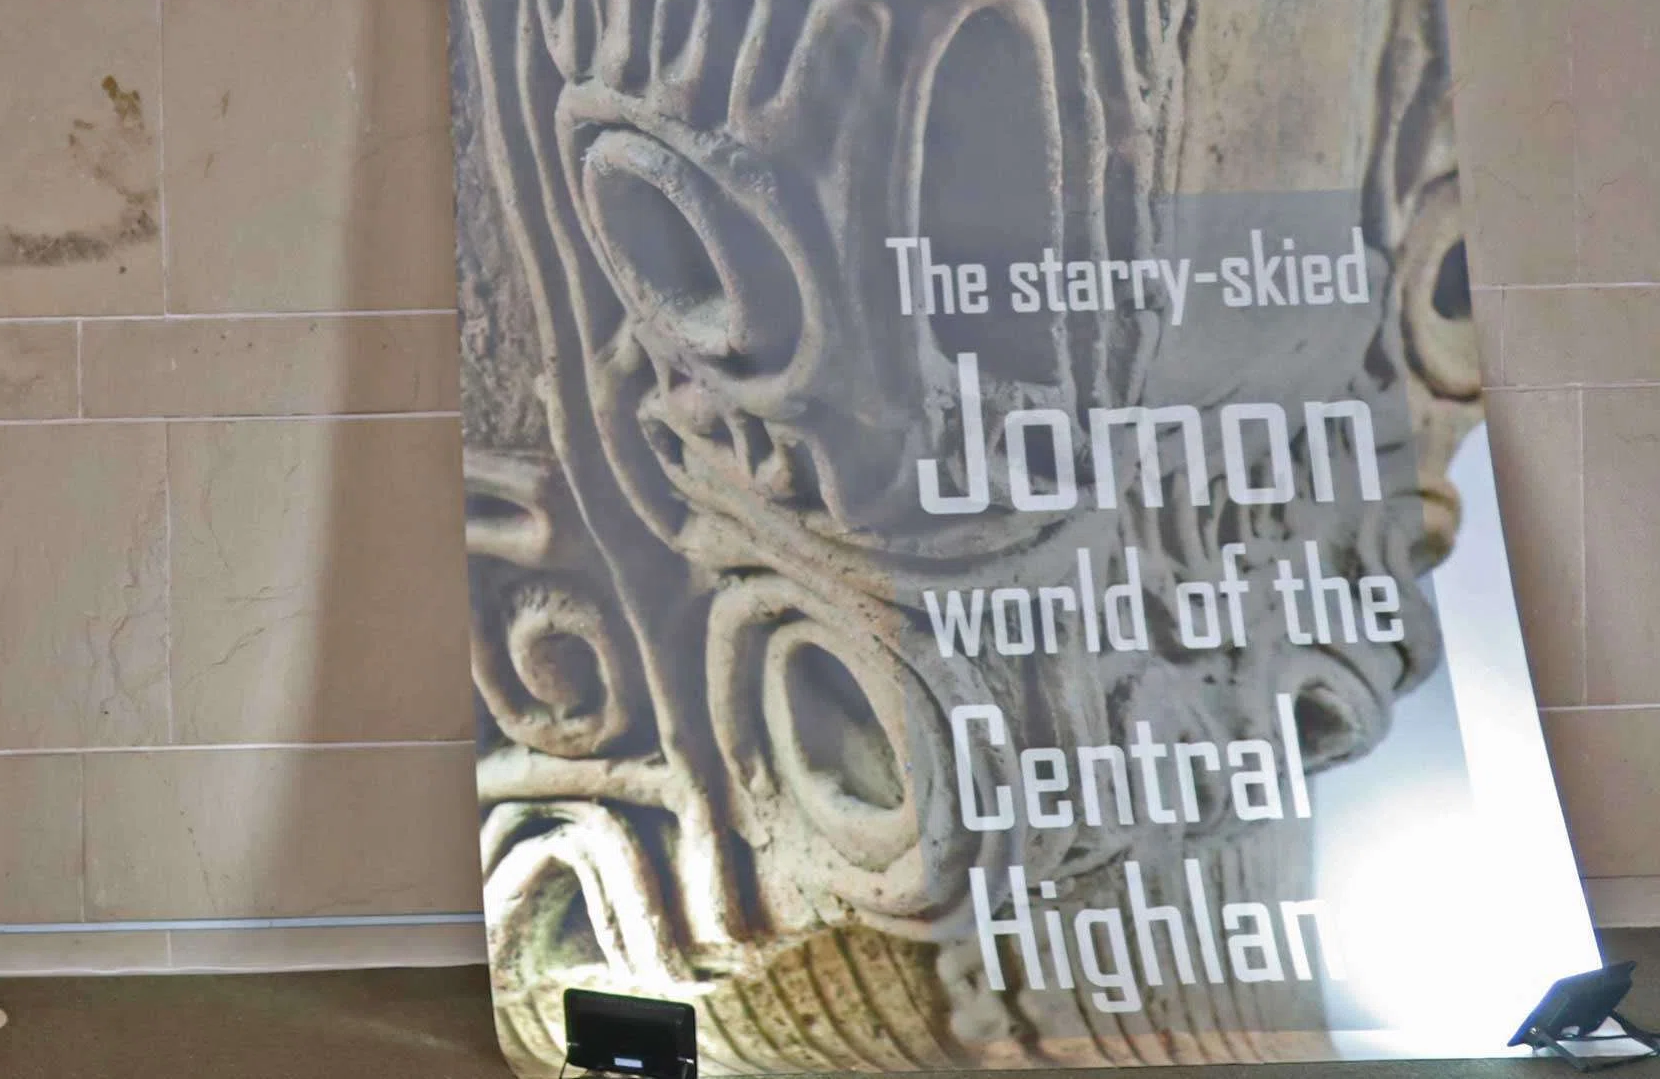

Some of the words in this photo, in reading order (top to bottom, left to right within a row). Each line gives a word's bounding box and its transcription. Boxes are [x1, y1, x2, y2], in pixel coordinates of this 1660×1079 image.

[885, 236, 990, 316] The
[1010, 226, 1371, 326] starry-skied
[916, 351, 1382, 515] Jomon
[922, 546, 1150, 660] world
[1176, 542, 1251, 651] of
[1273, 540, 1406, 649] the
[947, 693, 1313, 833] Central
[967, 858, 1348, 1016] Highlan
